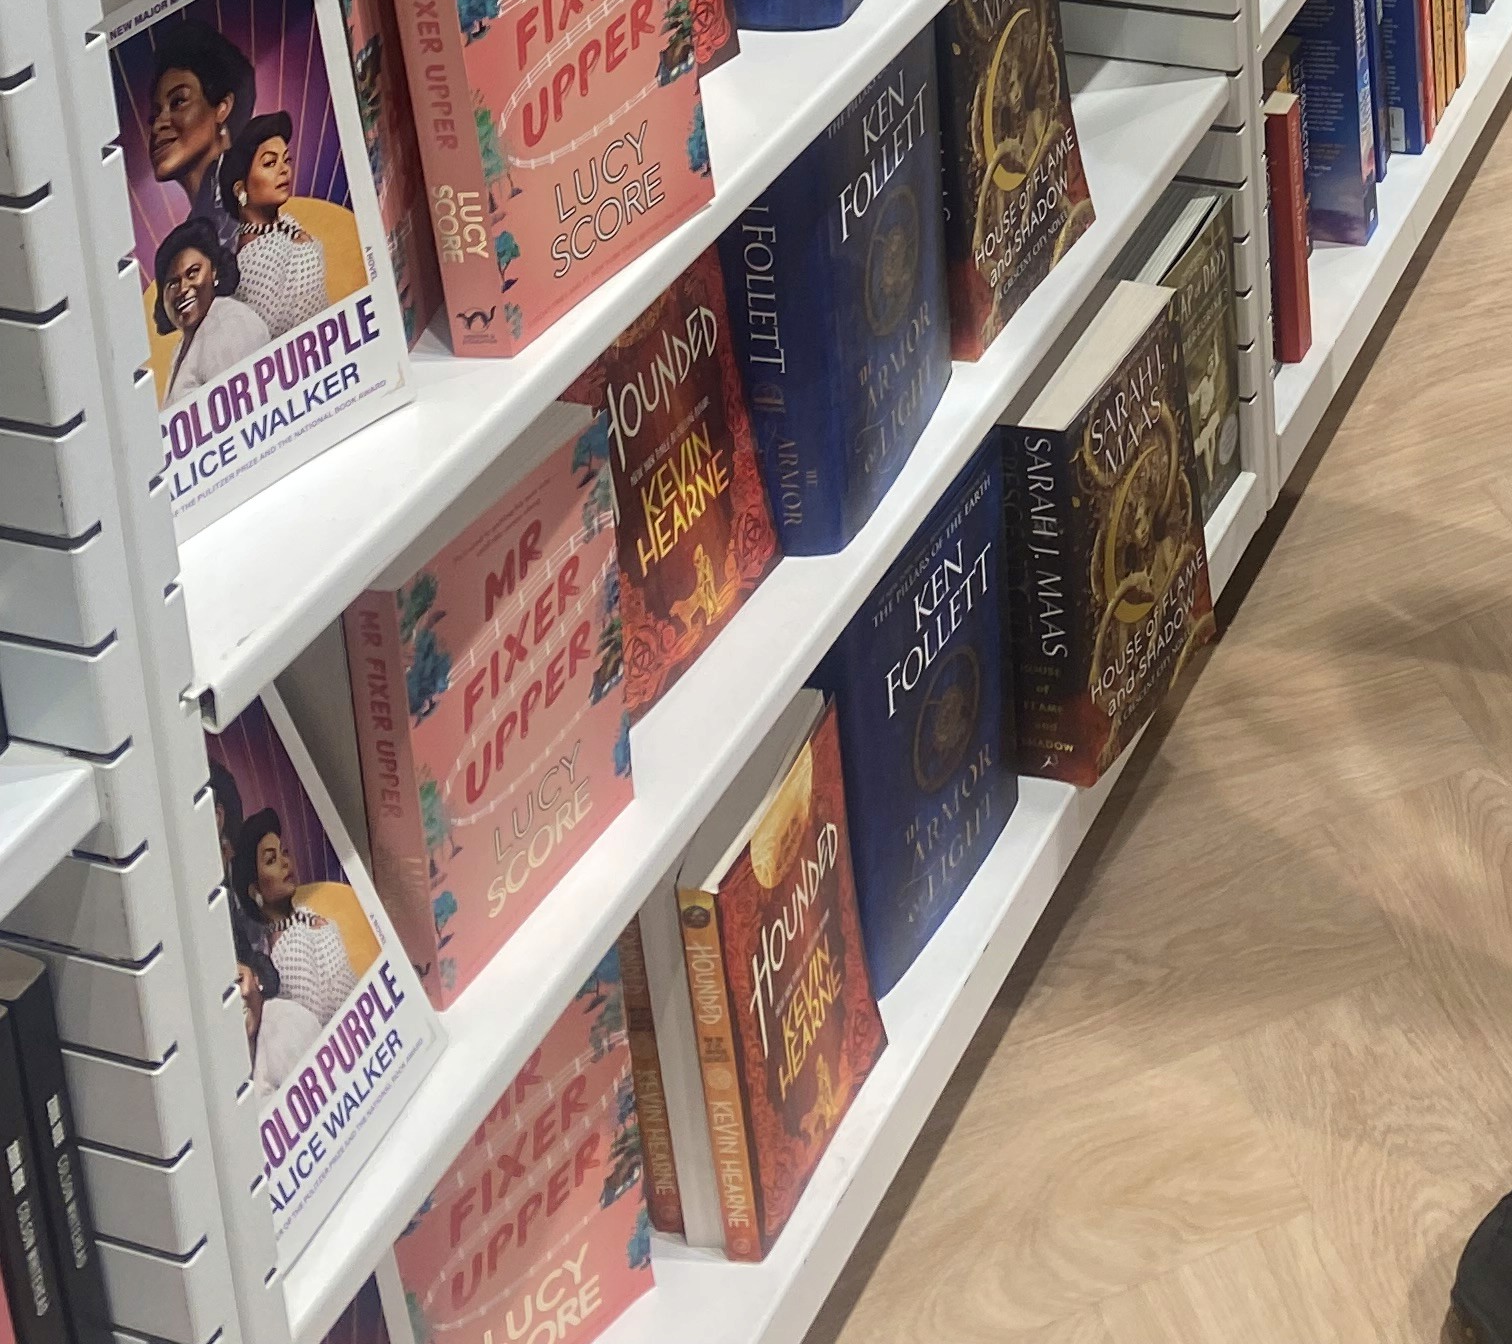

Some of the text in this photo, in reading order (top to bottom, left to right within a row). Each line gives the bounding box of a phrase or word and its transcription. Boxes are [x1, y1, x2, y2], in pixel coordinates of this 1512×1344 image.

[109, 21, 135, 42] NEW
[133, 2, 169, 27] MAJOR
[549, 163, 667, 280] SCORE
[552, 120, 652, 224] LUCY
[254, 293, 382, 396] PURPLE
[240, 361, 362, 451] WALKER
[605, 305, 719, 527] HOUNDED
[635, 450, 731, 582] HEARNE
[640, 421, 712, 517] KEVIN
[884, 542, 992, 721] FOLLETT
[912, 539, 964, 633] KEN
[749, 822, 838, 1059] HOUNDED
[782, 934, 831, 1038] KEVIN
[778, 959, 844, 1102] HEARNE
